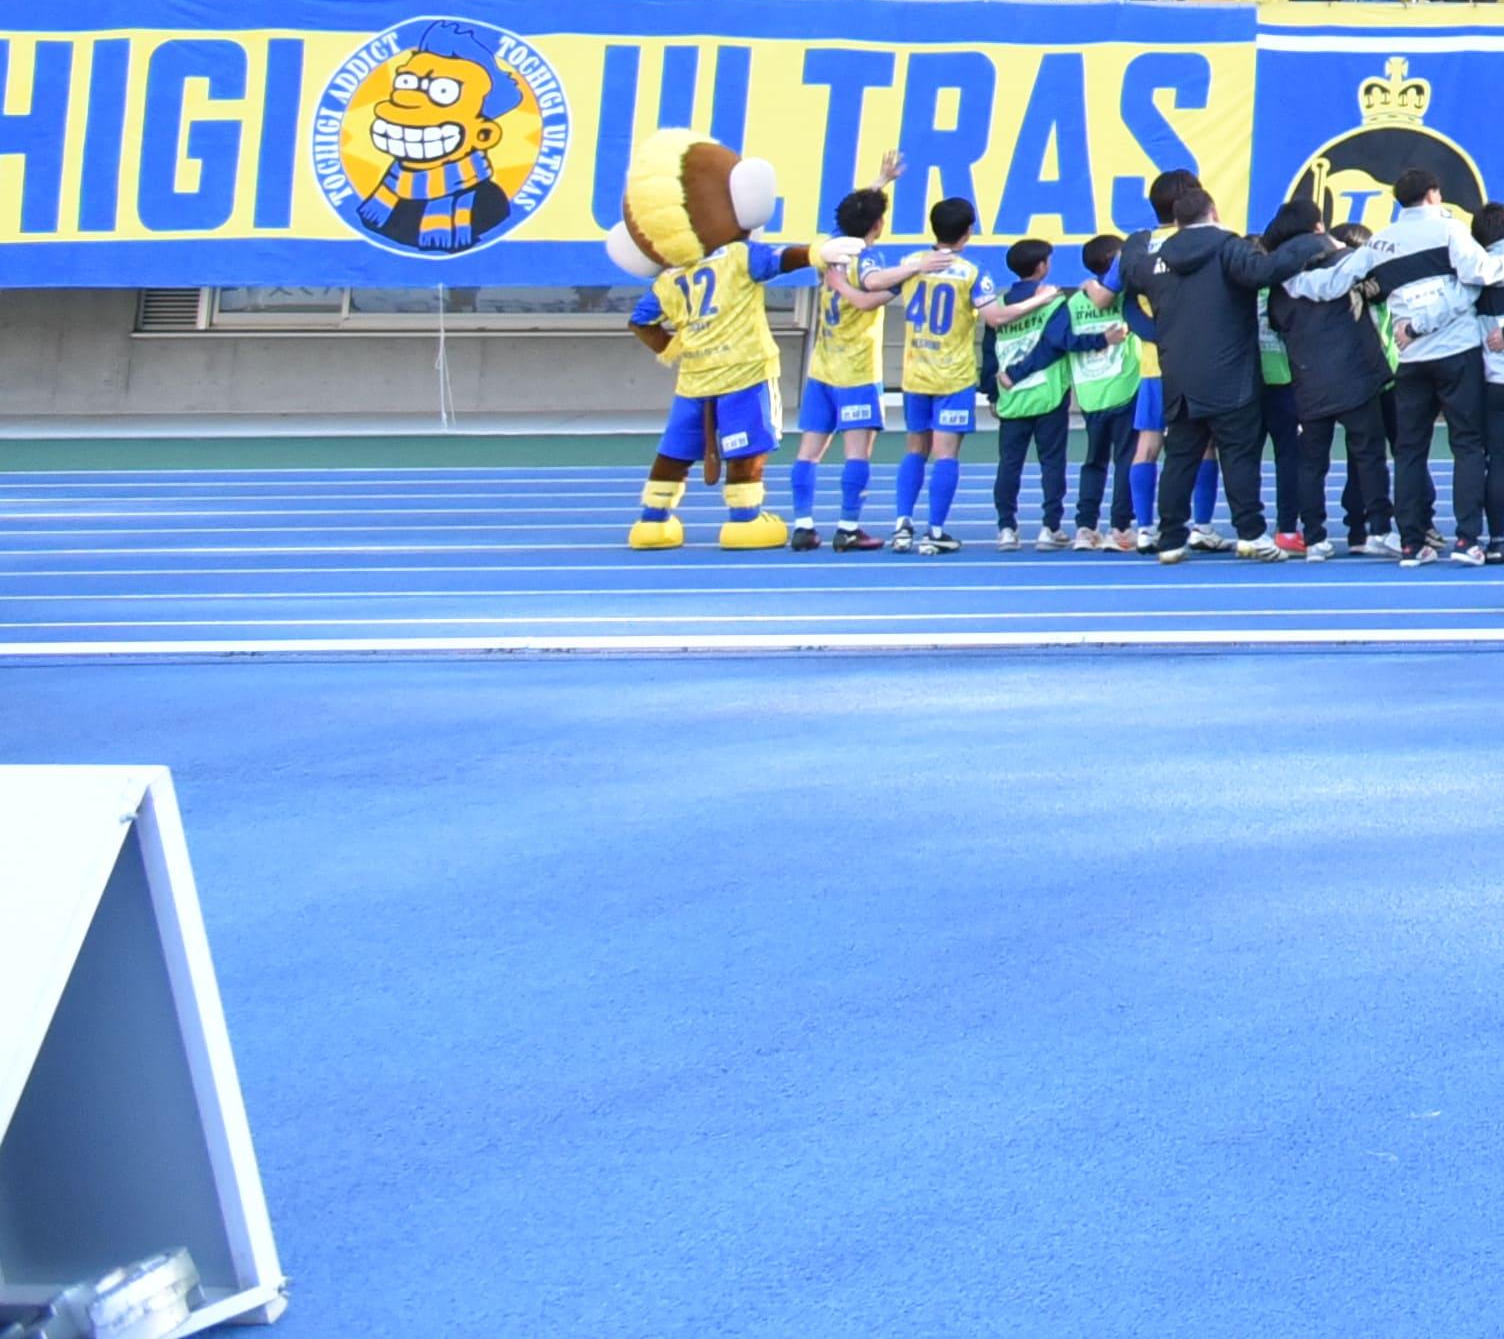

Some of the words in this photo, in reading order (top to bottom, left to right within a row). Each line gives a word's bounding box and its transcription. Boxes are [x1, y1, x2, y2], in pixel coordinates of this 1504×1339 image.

[327, 32, 400, 105] ADDICT
[498, 36, 565, 121] TOCHIGI
[312, 106, 355, 208] TOCHIGI
[512, 123, 566, 212] ULTRAS
[674, 266, 720, 319] 12
[905, 280, 956, 336] 40
